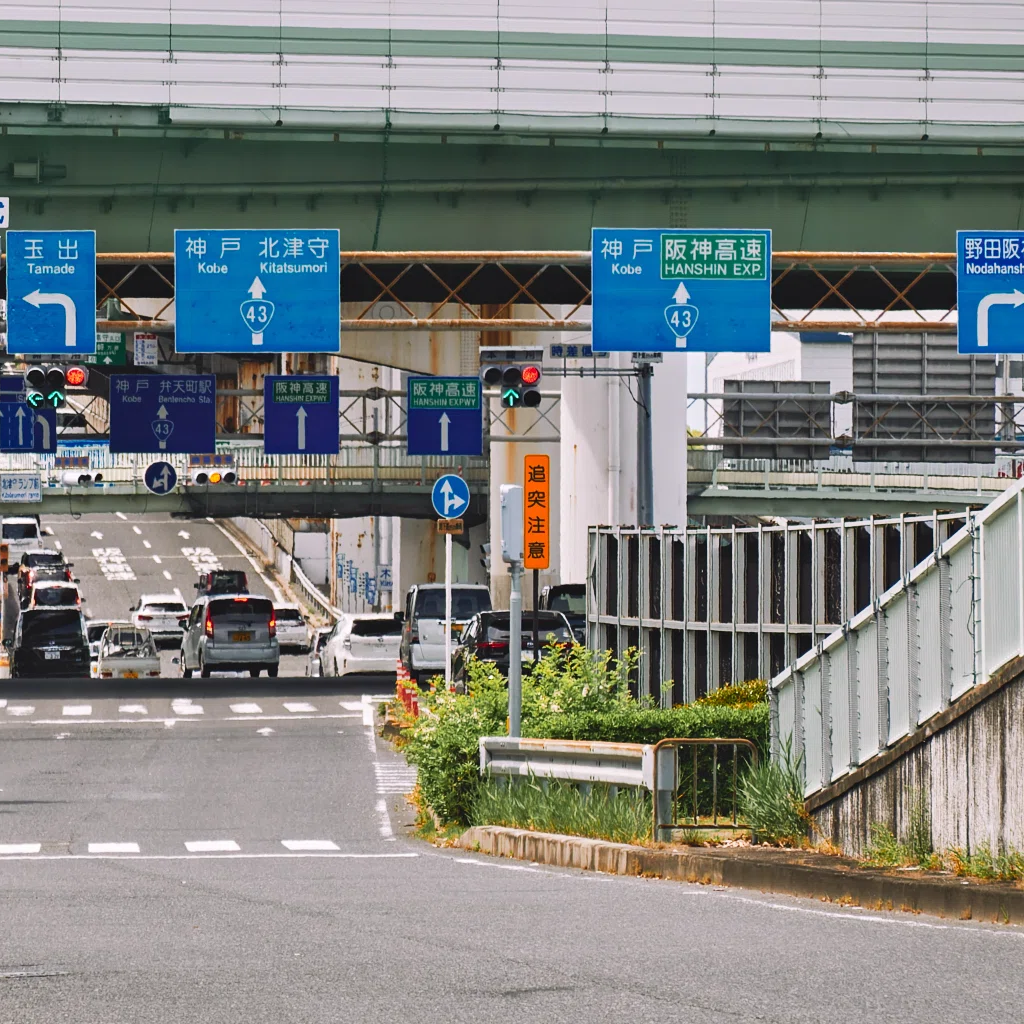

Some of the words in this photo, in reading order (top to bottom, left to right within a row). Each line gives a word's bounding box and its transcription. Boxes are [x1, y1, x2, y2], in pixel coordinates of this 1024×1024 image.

[24, 239, 78, 260] 玉出
[185, 237, 241, 260] 神戸
[258, 237, 329, 259] 北津守
[601, 238, 653, 260] 神戸
[665, 238, 762, 261] 阪神高速
[965, 238, 1024, 260] 野田阪
[27, 263, 75, 274] Tamade
[198, 262, 228, 274] Kobe
[260, 261, 328, 274] Kitatsumori
[611, 263, 642, 275] Kobe
[665, 263, 727, 276] HANSHIN
[733, 263, 763, 277] EXP.
[246, 306, 268, 323] 43
[670, 311, 692, 328] 43
[115, 379, 149, 394] 神戸
[159, 379, 212, 394] 弁天町駅
[276, 381, 328, 395] 阪神高速
[413, 383, 477, 397] 阪神高速
[122, 395, 142, 403] Kobe
[413, 398, 447, 406] HANSHIN
[449, 398, 476, 406] EXPWY
[155, 423, 170, 435] 43
[528, 465, 546, 559] 追突注意
